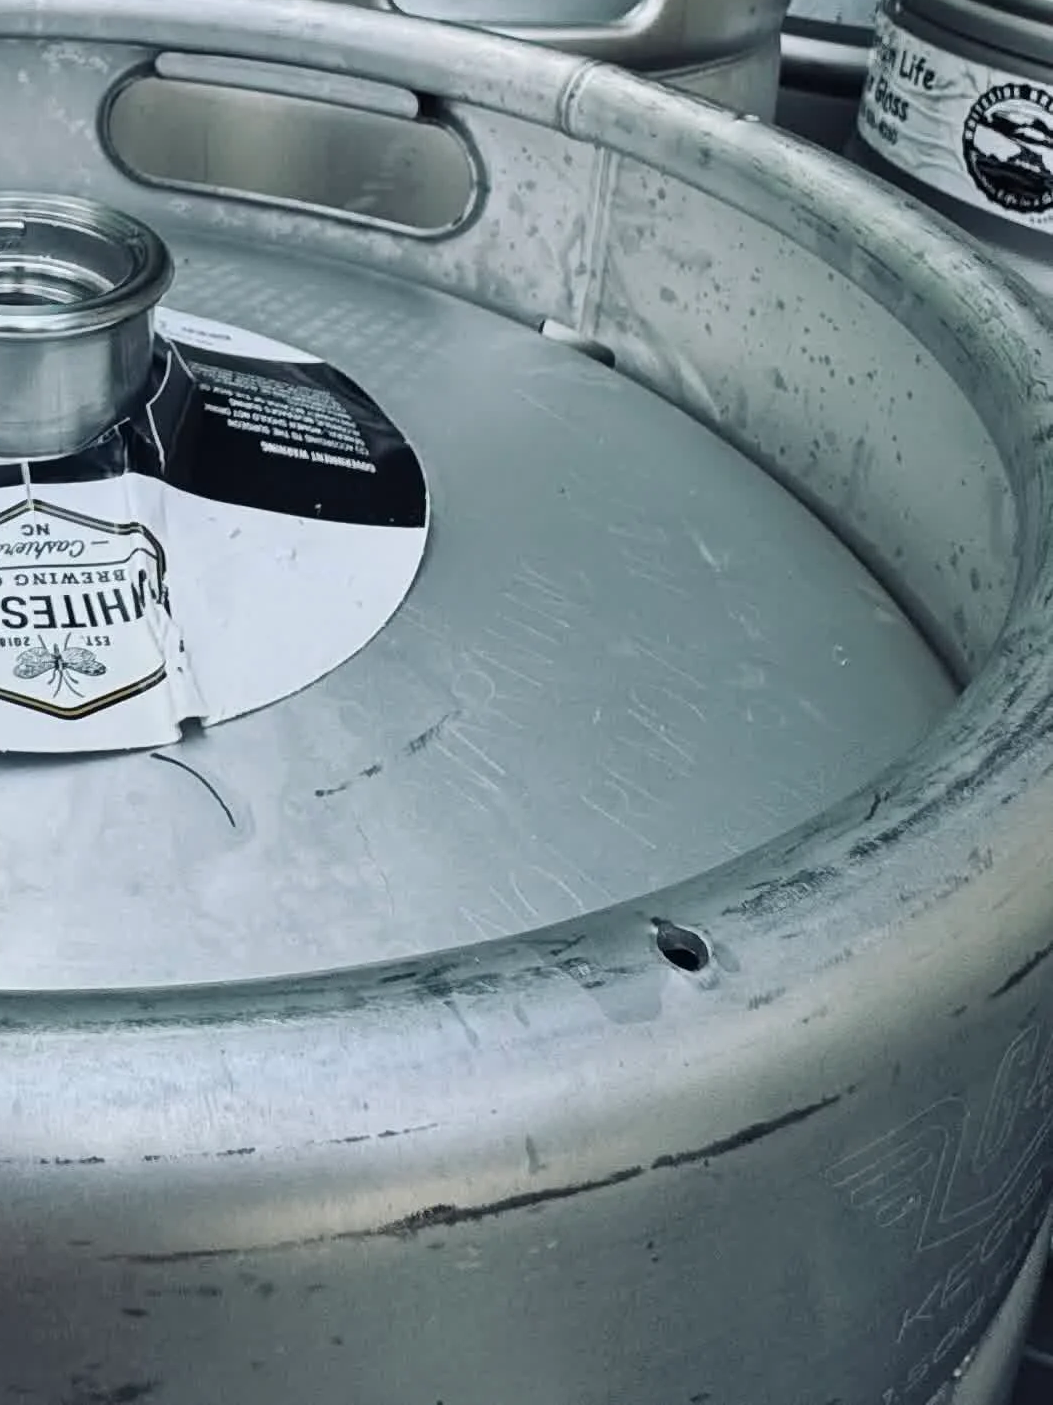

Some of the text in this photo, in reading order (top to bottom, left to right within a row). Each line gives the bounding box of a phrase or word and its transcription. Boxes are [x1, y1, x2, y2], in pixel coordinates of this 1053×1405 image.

[899, 50, 935, 91] Life
[21, 522, 51, 537] NC
[14, 568, 127, 586] BREWING
